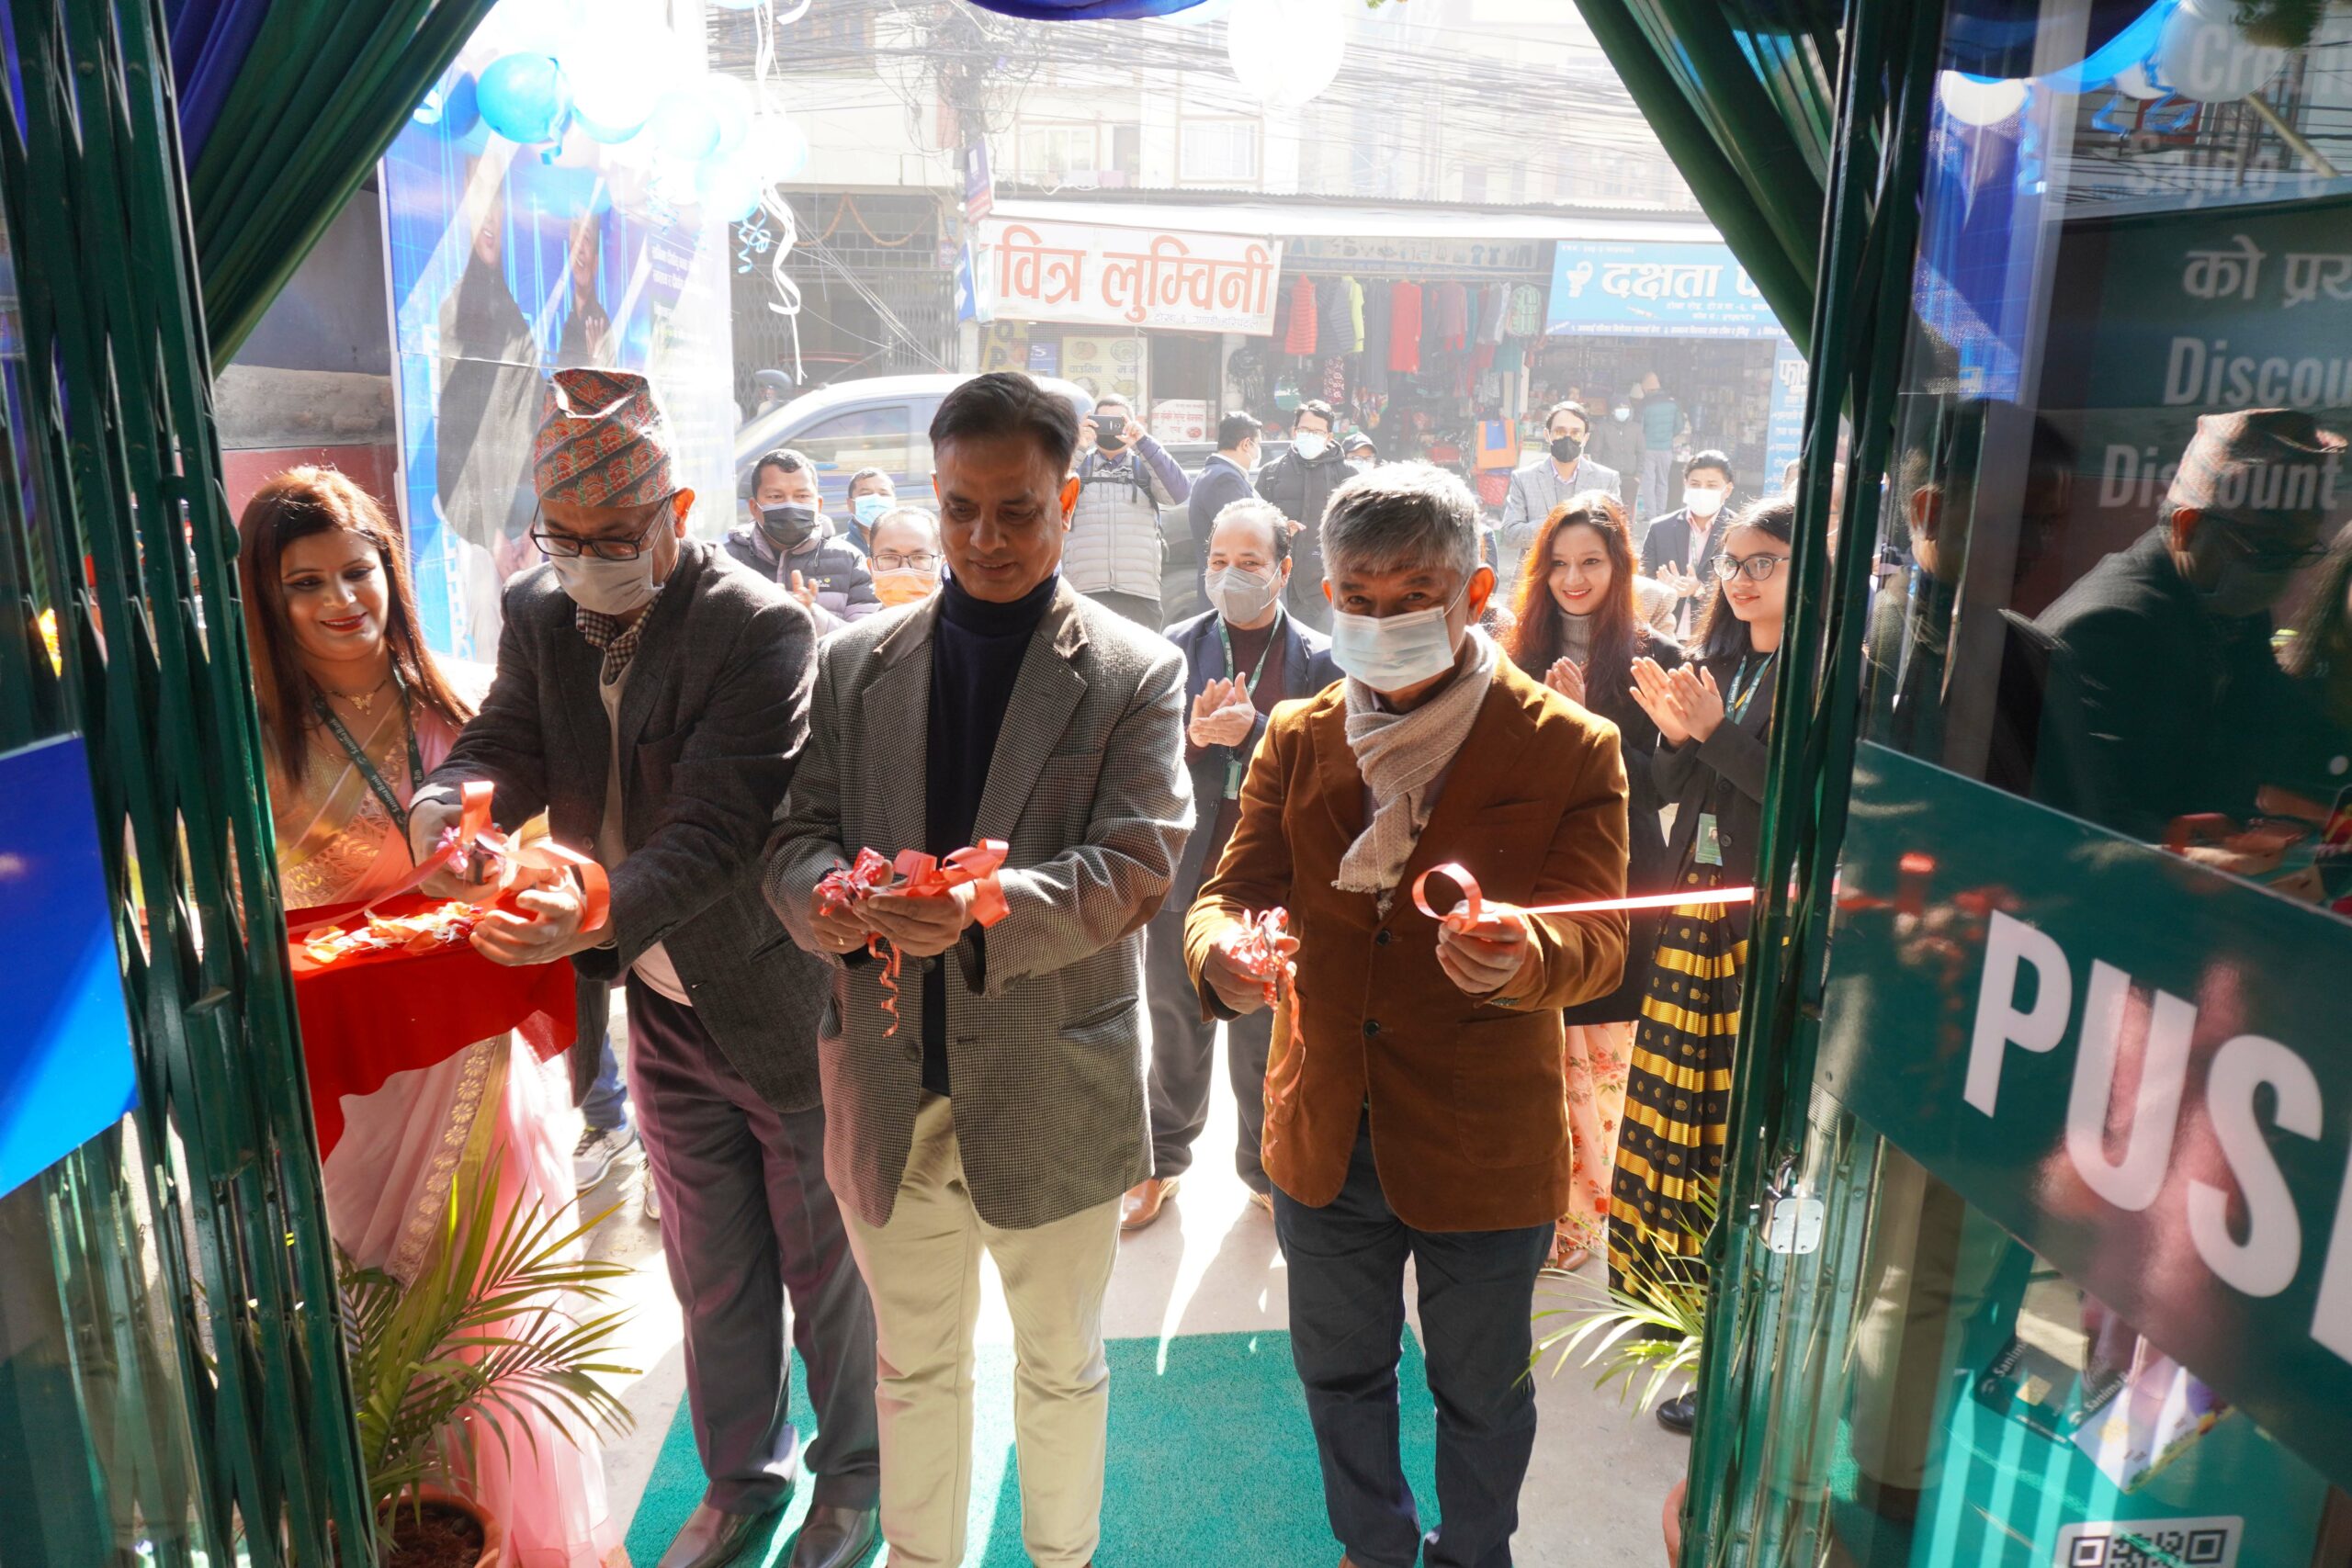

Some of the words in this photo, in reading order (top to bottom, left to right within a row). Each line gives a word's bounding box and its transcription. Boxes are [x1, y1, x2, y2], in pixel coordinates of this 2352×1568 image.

[1601, 262, 1724, 301] दक्षता
[2182, 234, 2267, 300] को
[2098, 442, 2344, 511] Diount
